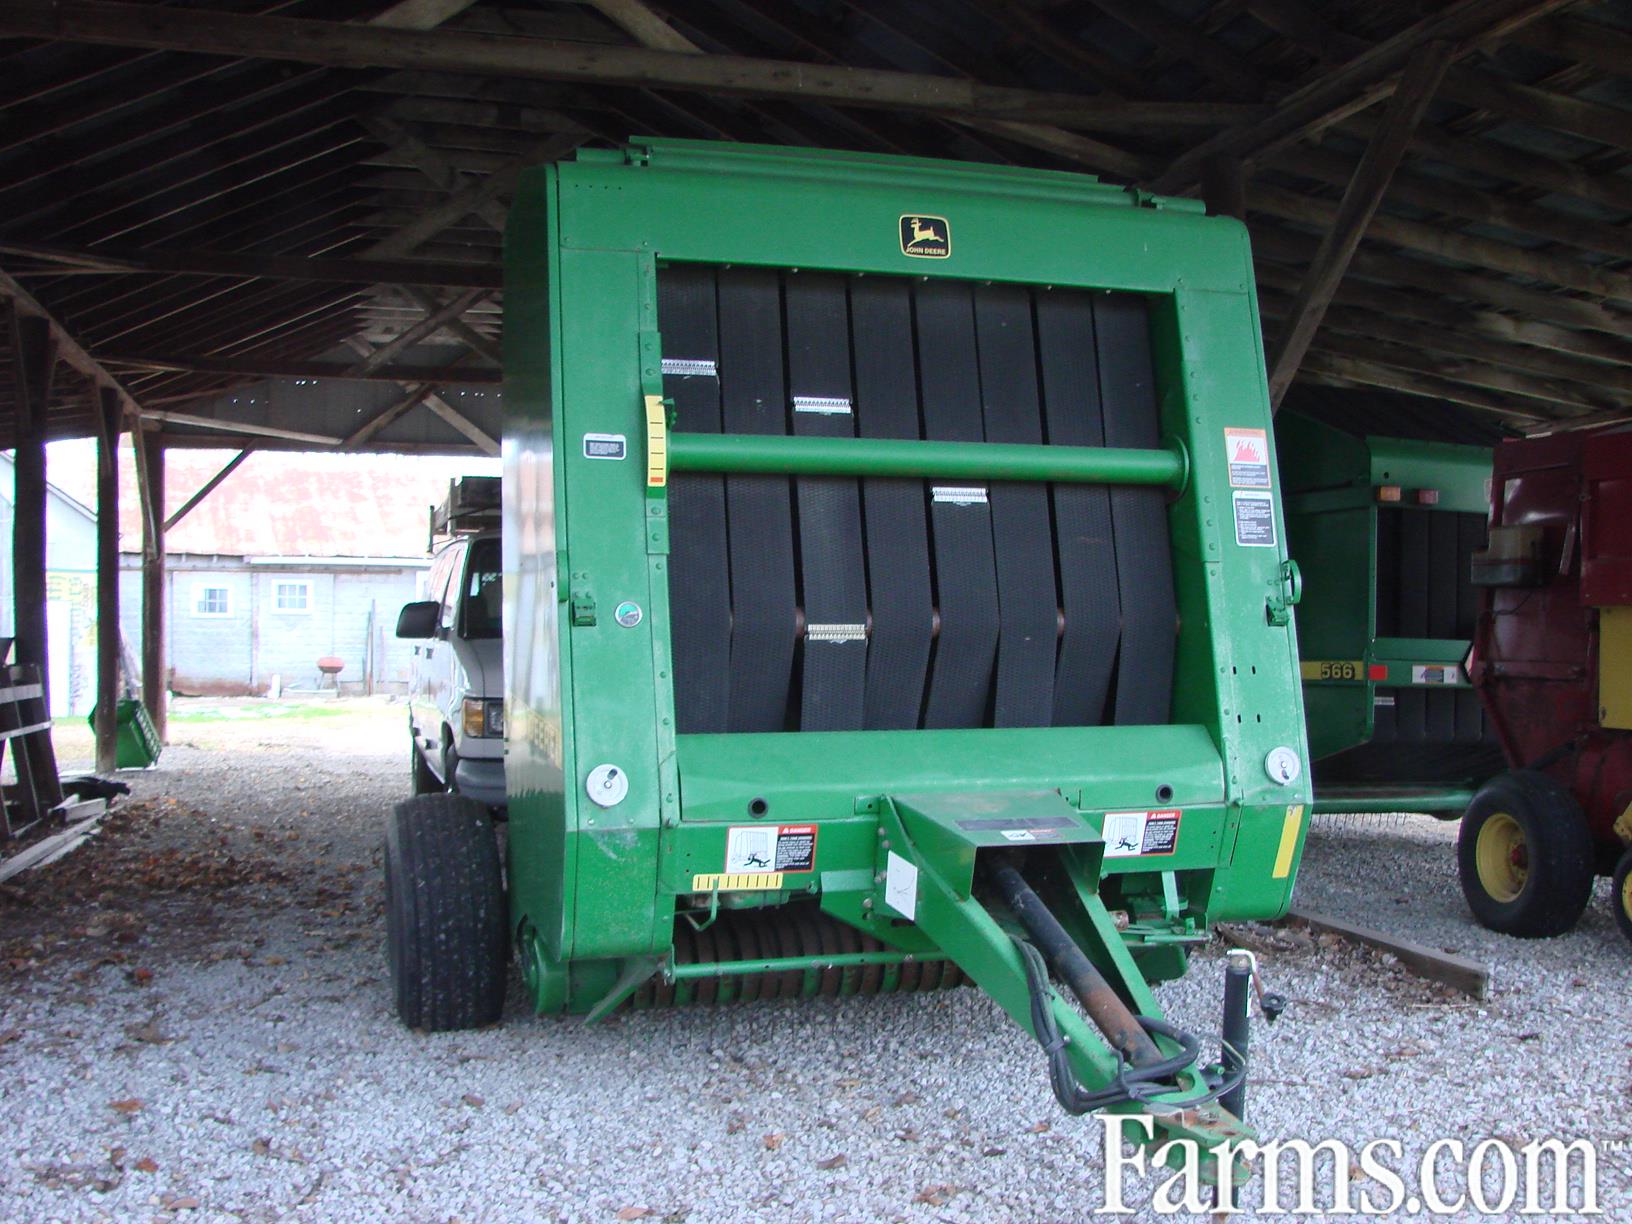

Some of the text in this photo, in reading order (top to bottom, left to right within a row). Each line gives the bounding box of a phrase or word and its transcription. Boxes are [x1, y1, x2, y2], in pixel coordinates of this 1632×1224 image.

[906, 246, 946, 255] JOHN DEERE
[1321, 663, 1355, 679] 566
